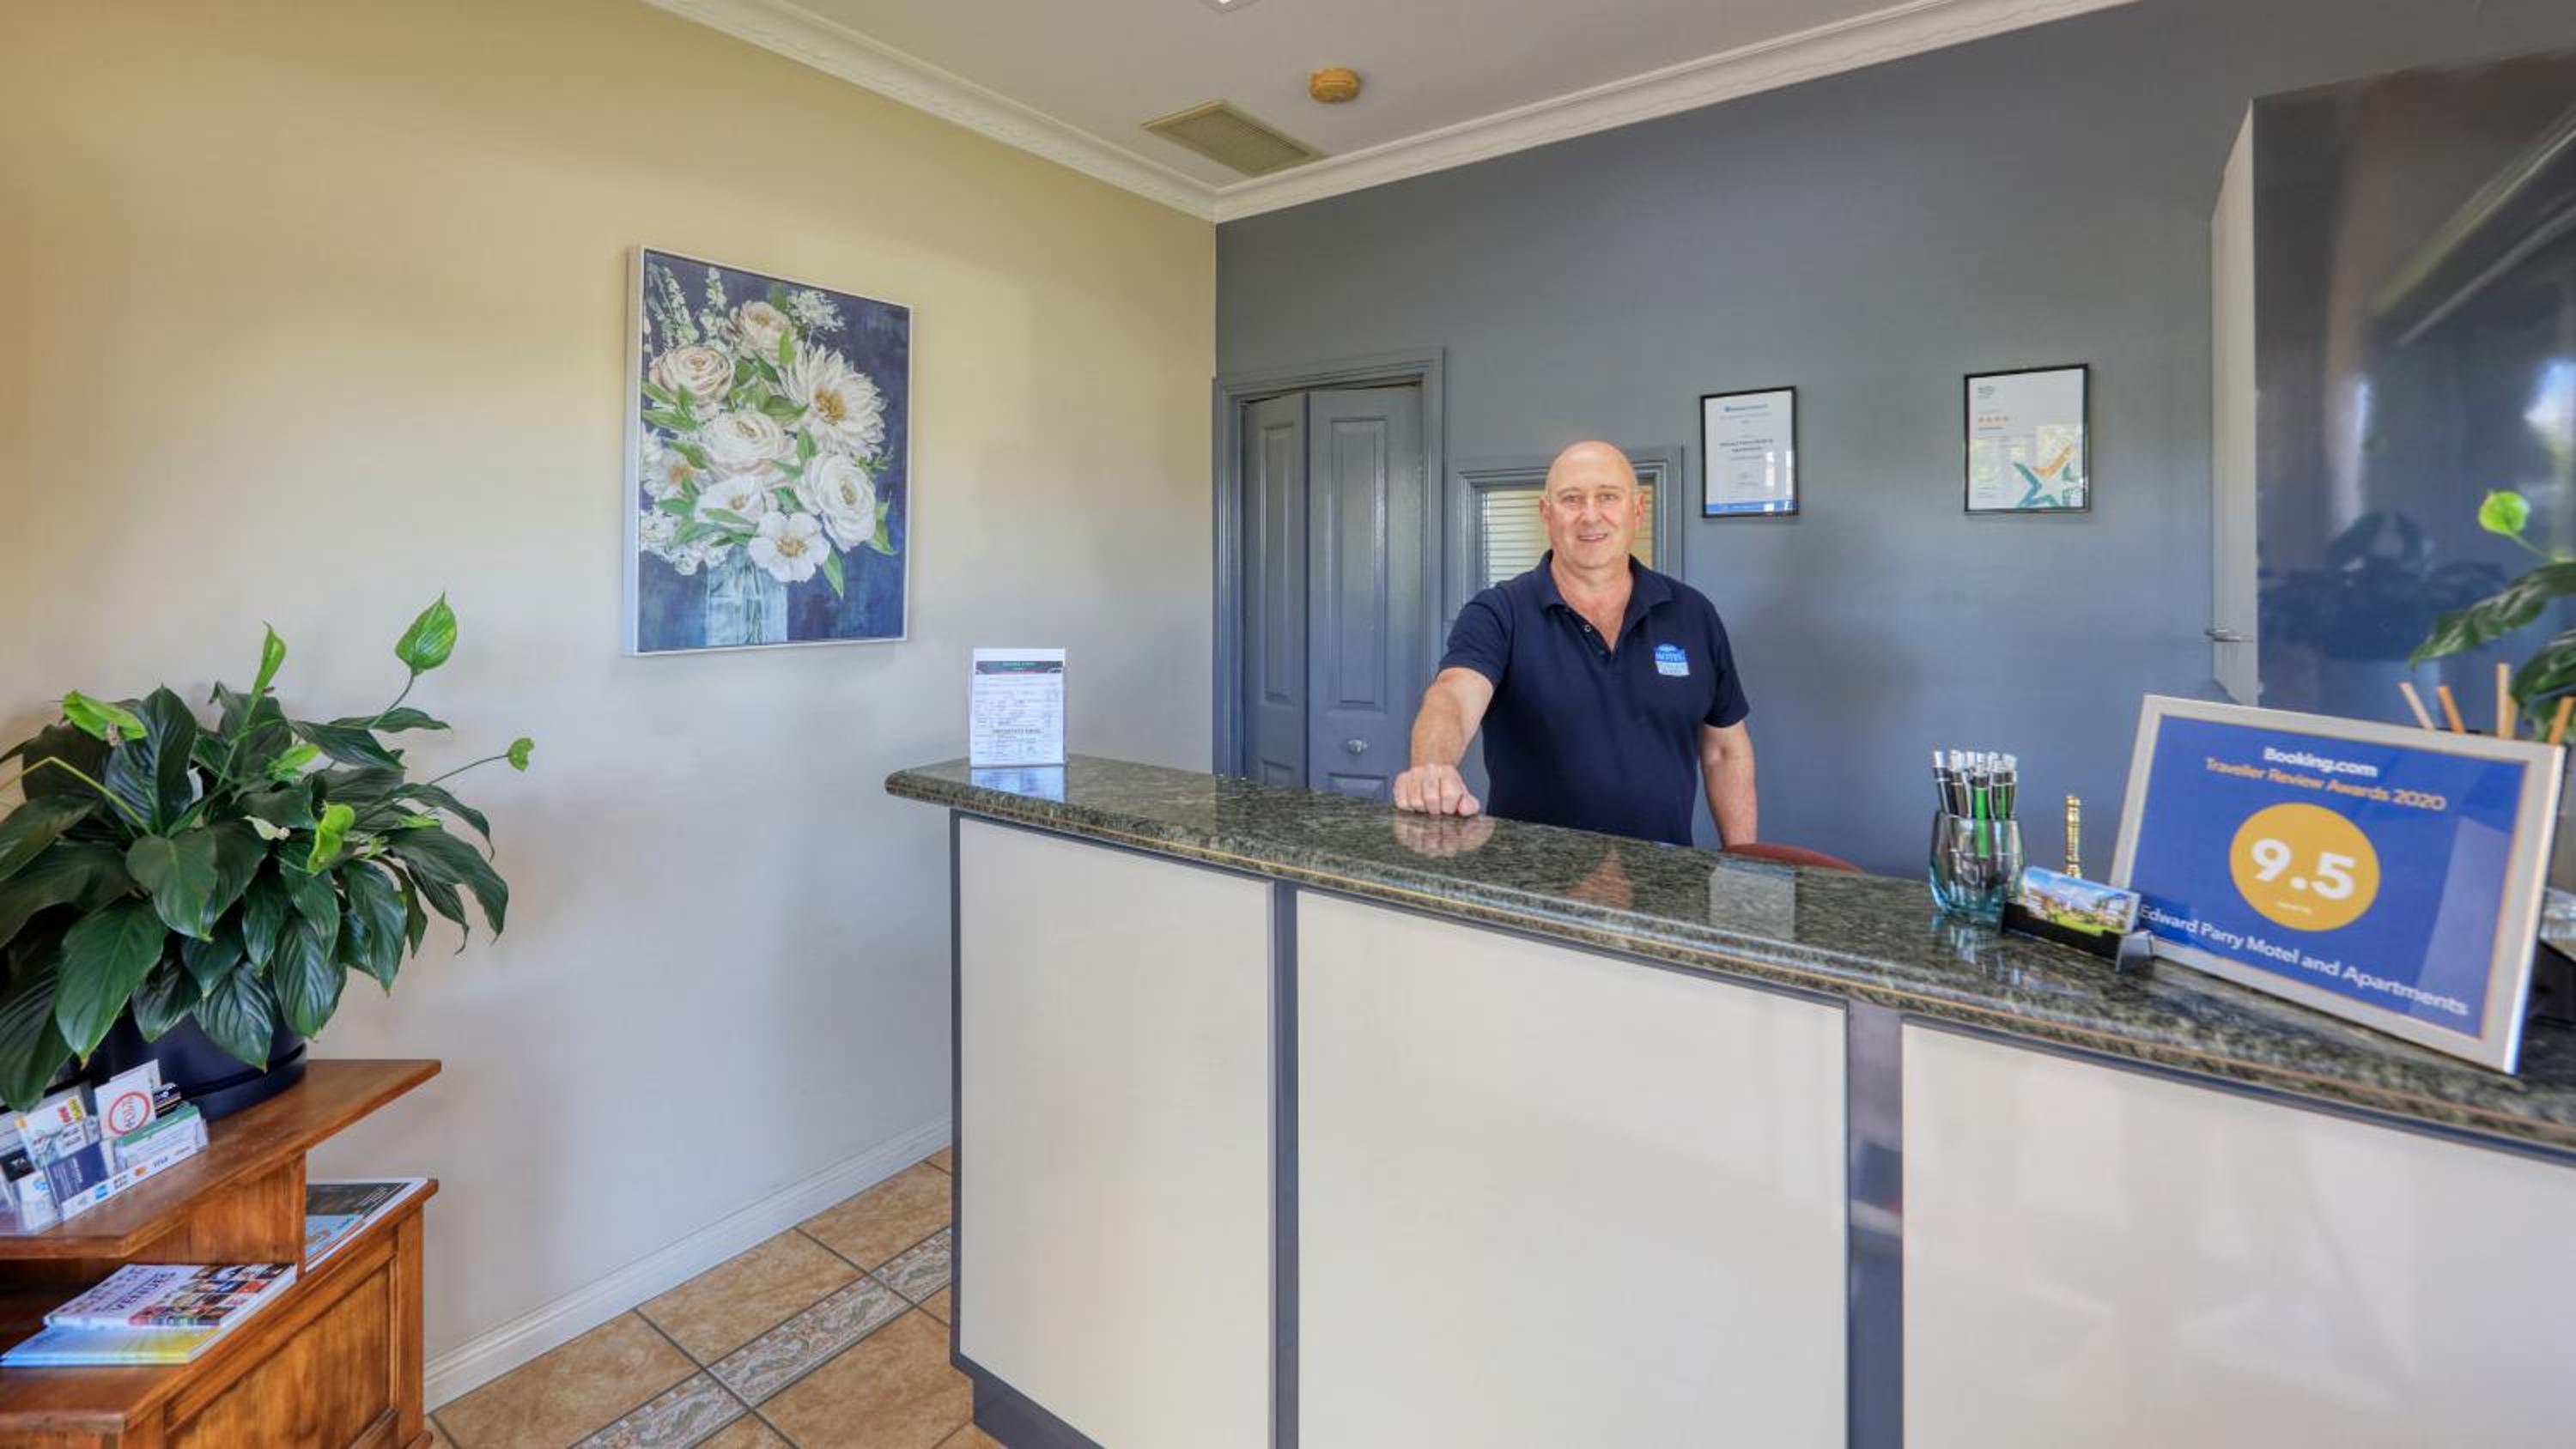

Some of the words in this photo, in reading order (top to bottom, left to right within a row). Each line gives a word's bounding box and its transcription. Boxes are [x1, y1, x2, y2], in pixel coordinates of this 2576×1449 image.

[2205, 757, 2264, 779] Traveller
[2269, 768, 2324, 790] Review
[2326, 779, 2391, 802] Awards
[2393, 788, 2446, 811] 2020
[2263, 746, 2378, 777] Booking.com
[2251, 837, 2357, 900] 9.5
[2141, 904, 2199, 934] Edward
[2200, 922, 2245, 950] Parry
[2246, 936, 2300, 964] Motel
[2301, 955, 2341, 976] and
[2342, 965, 2470, 1016] Apartments
